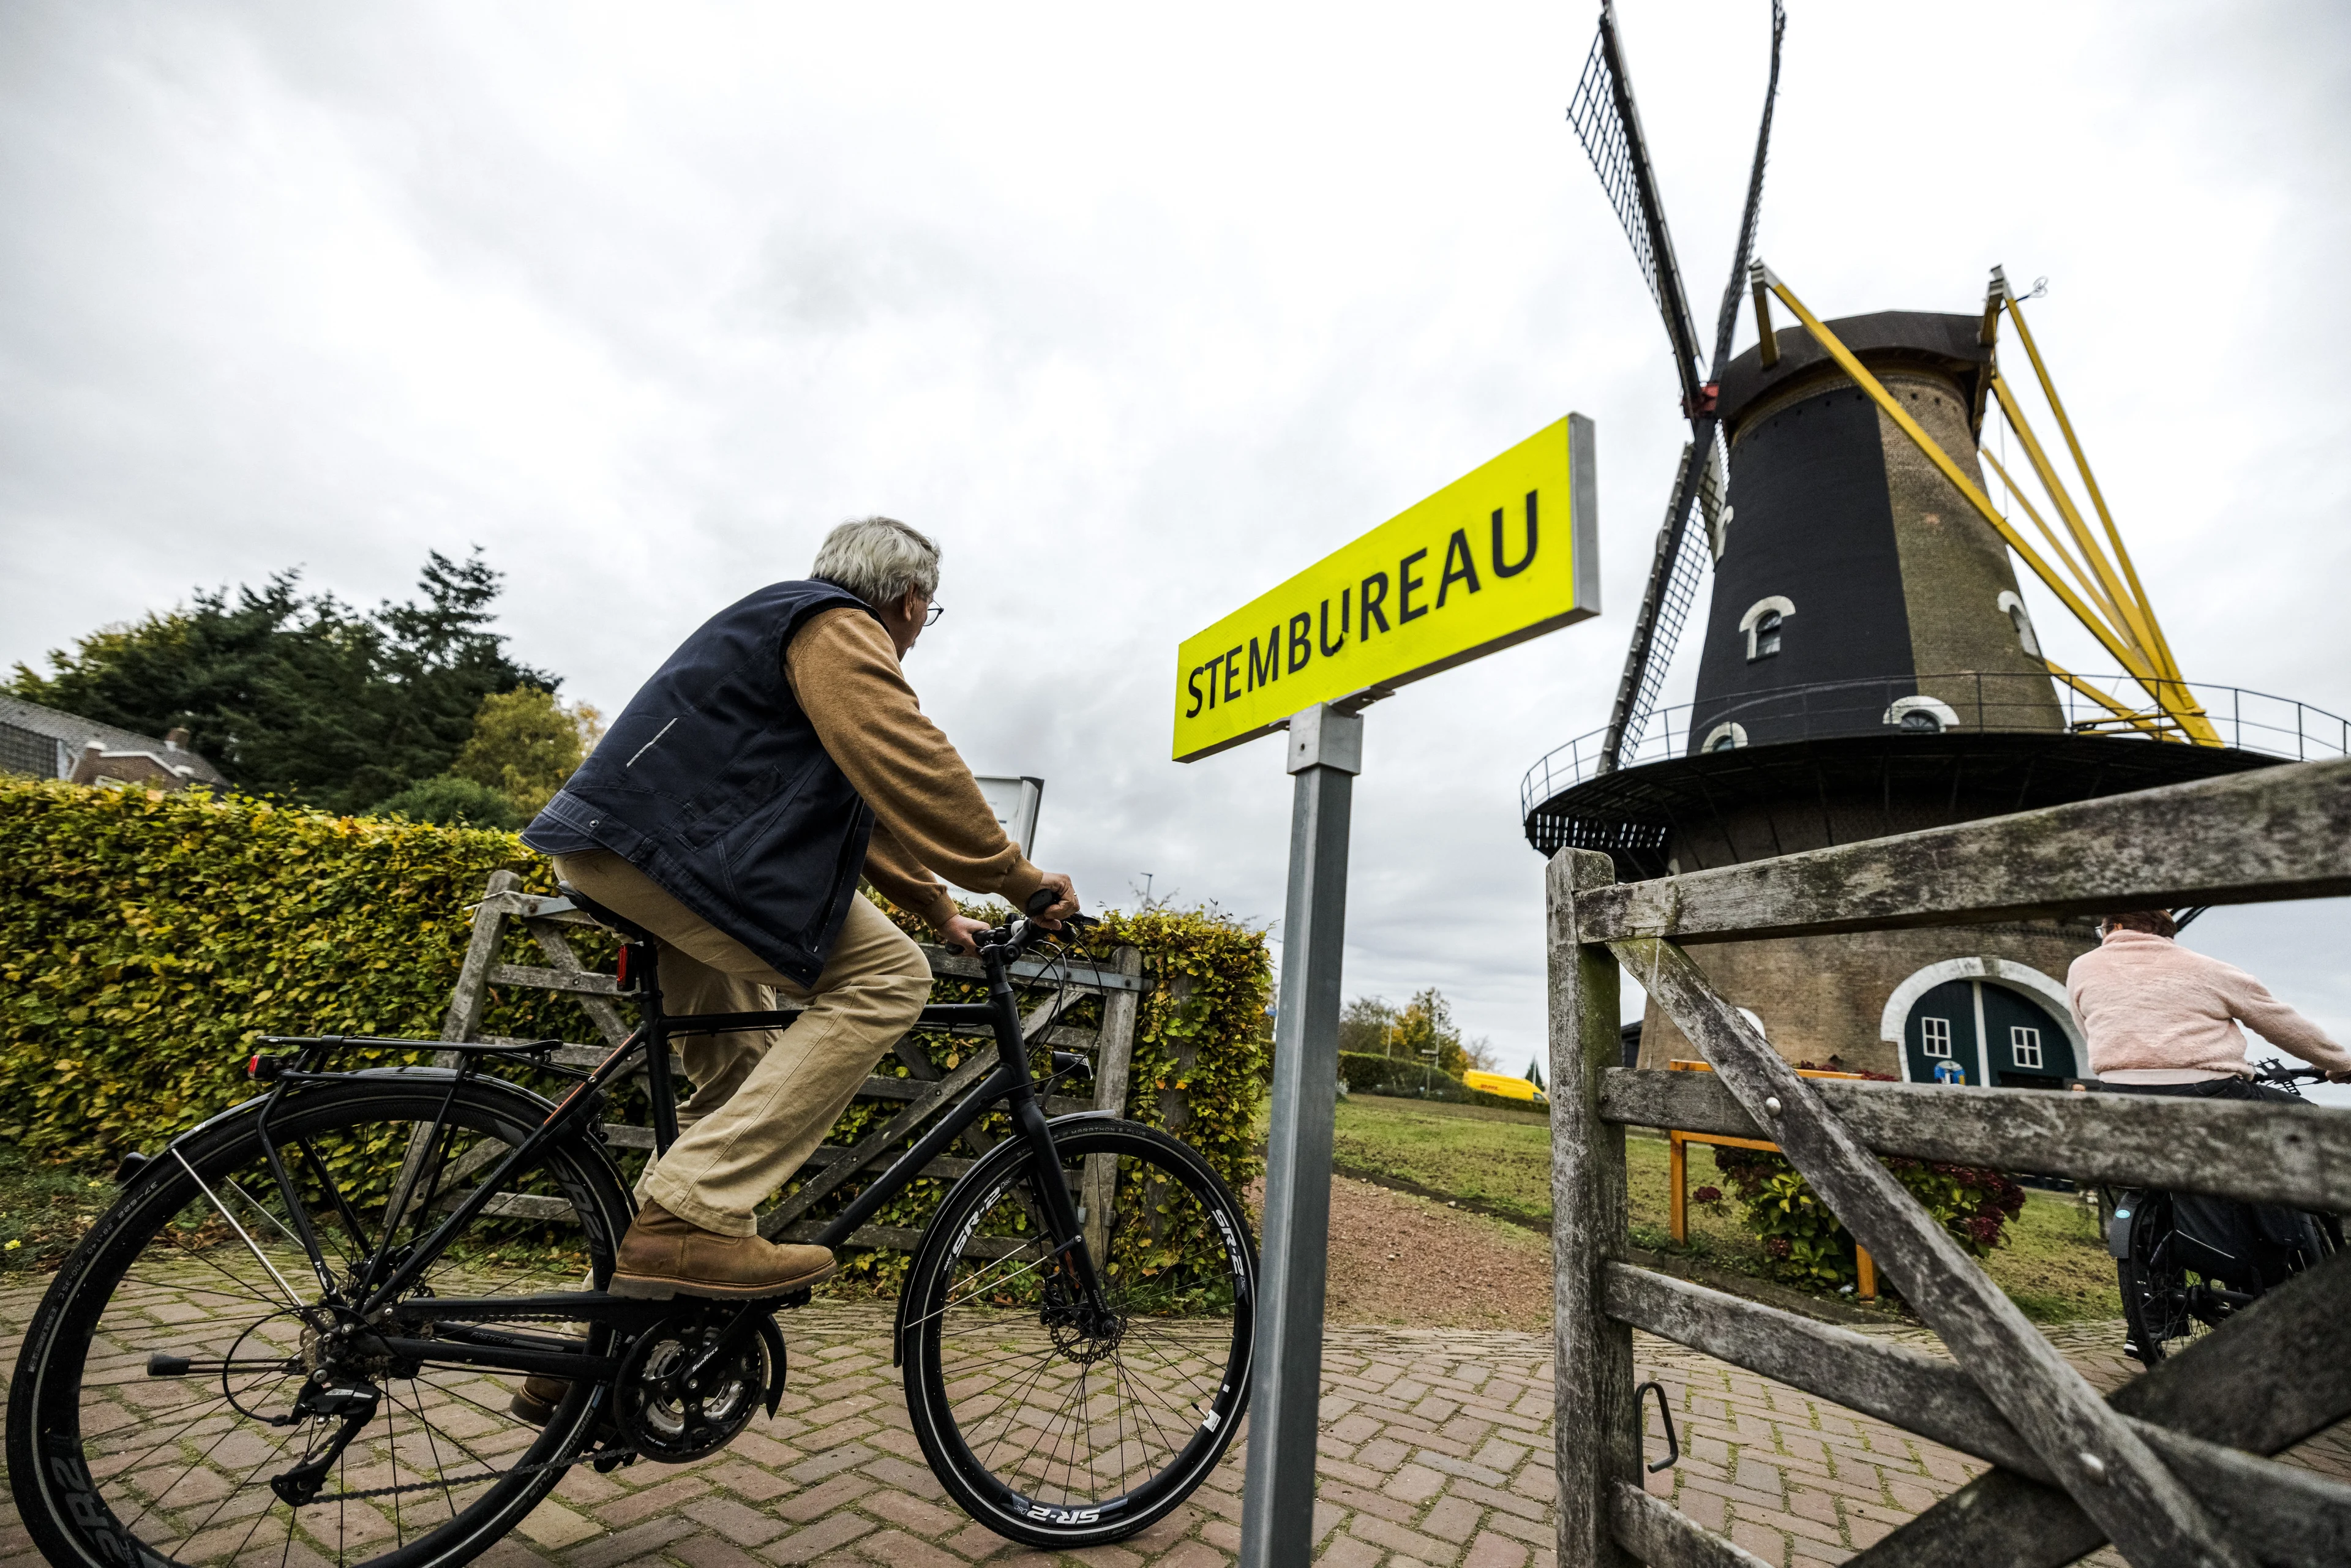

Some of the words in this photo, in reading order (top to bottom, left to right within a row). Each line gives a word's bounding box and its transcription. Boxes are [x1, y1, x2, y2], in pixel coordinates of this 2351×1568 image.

[1186, 489, 1539, 718] STEMBUREAU
[118, 1181, 158, 1219] 37-622
[953, 1187, 1002, 1258] SR-2
[1212, 1209, 1244, 1276] SR-2
[943, 1253, 953, 1272] GIANT
[1093, 1289, 1105, 1313] GIANT
[470, 1332, 513, 1344] FASTCITY
[530, 1470, 553, 1498] PLUS
[1027, 1505, 1100, 1524] SR-2
